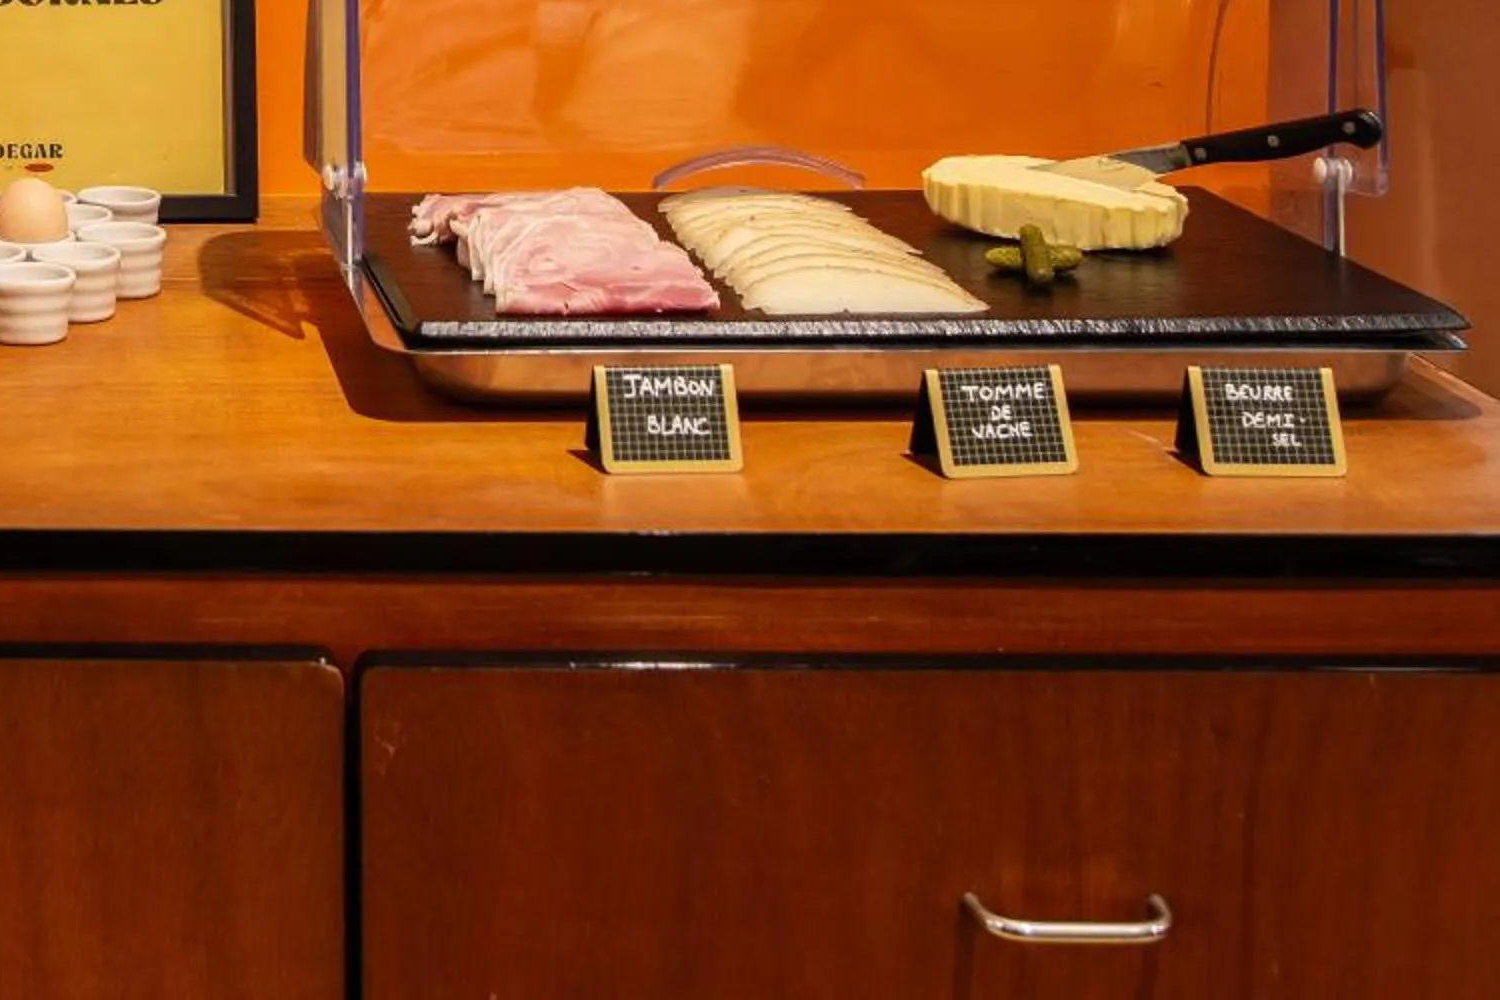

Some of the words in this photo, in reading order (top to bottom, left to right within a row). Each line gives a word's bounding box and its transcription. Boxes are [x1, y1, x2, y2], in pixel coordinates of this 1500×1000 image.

[622, 374, 714, 398] JAMBON
[960, 382, 1046, 401] TOMME
[1224, 383, 1293, 401] BEURRE
[991, 405, 1012, 421] DE
[647, 415, 711, 435] BLANC
[972, 421, 1032, 438] VACHE
[1271, 433, 1302, 447] SEL
